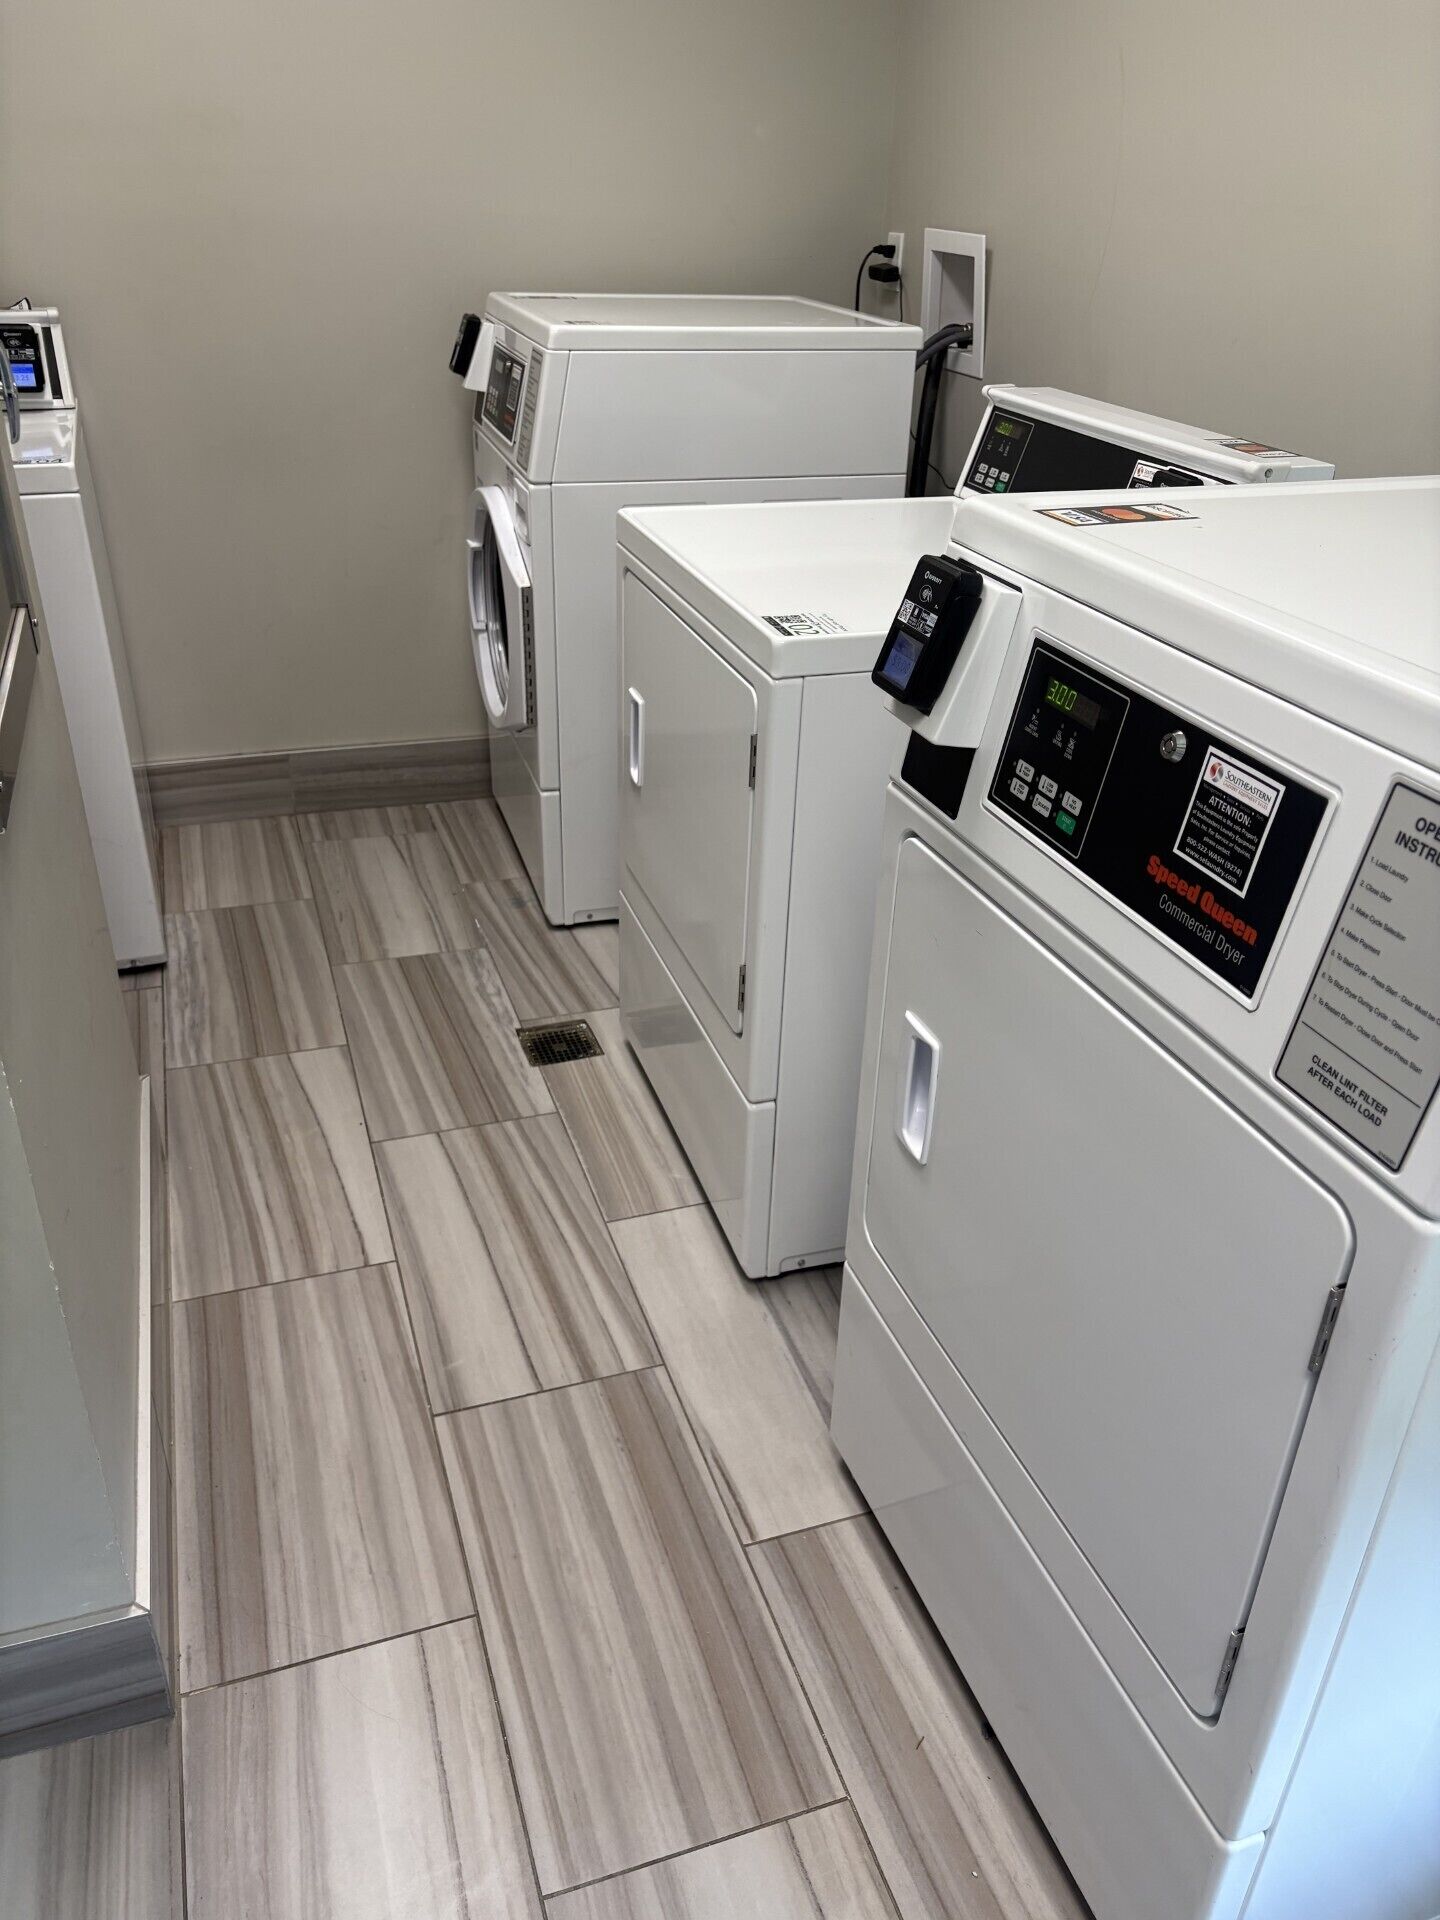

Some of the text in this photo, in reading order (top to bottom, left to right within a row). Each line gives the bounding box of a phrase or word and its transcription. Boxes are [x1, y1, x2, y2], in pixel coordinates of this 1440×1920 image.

[1048, 680, 1078, 711] 3.00
[1225, 770, 1272, 803] SOUTHEASTERN
[1203, 805, 1222, 821] Equipment
[1241, 828, 1258, 843] Property
[1208, 794, 1252, 827] ATTENTION:
[1196, 811, 1220, 829] Southeastern
[1219, 825, 1235, 839] Laundry
[1235, 835, 1255, 851] Equipment
[1215, 832, 1228, 844] Service
[1184, 845, 1237, 885] www.selaundry.com
[1186, 835, 1242, 877] 800-522-WASH (9274)
[1375, 859, 1388, 871] Load
[1388, 866, 1409, 883] Laundry
[1147, 855, 1258, 946] Speed Queen
[1365, 883, 1379, 895] Close
[1379, 890, 1392, 902] Door
[1159, 893, 1246, 966] Commercial Dryer
[1346, 930, 1359, 942] Make
[1359, 938, 1380, 956] Payment
[1355, 906, 1368, 918] Make
[1369, 914, 1382, 927] Cycle
[1383, 923, 1406, 941] Selection
[1336, 953, 1342, 961] To
[1342, 957, 1354, 968] Start
[1353, 964, 1367, 978] Dryer
[1371, 975, 1385, 989] Press
[1386, 984, 1397, 997] Start
[1401, 994, 1413, 1008] Door
[1415, 1003, 1427, 1017] Must
[1428, 1011, 1434, 1021] be
[1327, 976, 1333, 984] To
[1333, 980, 1344, 992] Stop
[1344, 987, 1356, 1001] Dryer
[1357, 996, 1373, 1012] During
[1374, 1007, 1387, 1022] Cycle
[1391, 1019, 1405, 1034] Open
[1406, 1029, 1418, 1042] Door
[1324, 1002, 1341, 1018] Restart
[1340, 1014, 1353, 1027] Dryer
[1357, 1024, 1370, 1038] Close
[1371, 1034, 1383, 1048] Door
[1384, 1043, 1393, 1054] and
[1394, 1050, 1408, 1066] Press
[1307, 1066, 1382, 1127] AFTER EACH LOAD
[1311, 1054, 1388, 1116] CLEAN LINT FILTER
